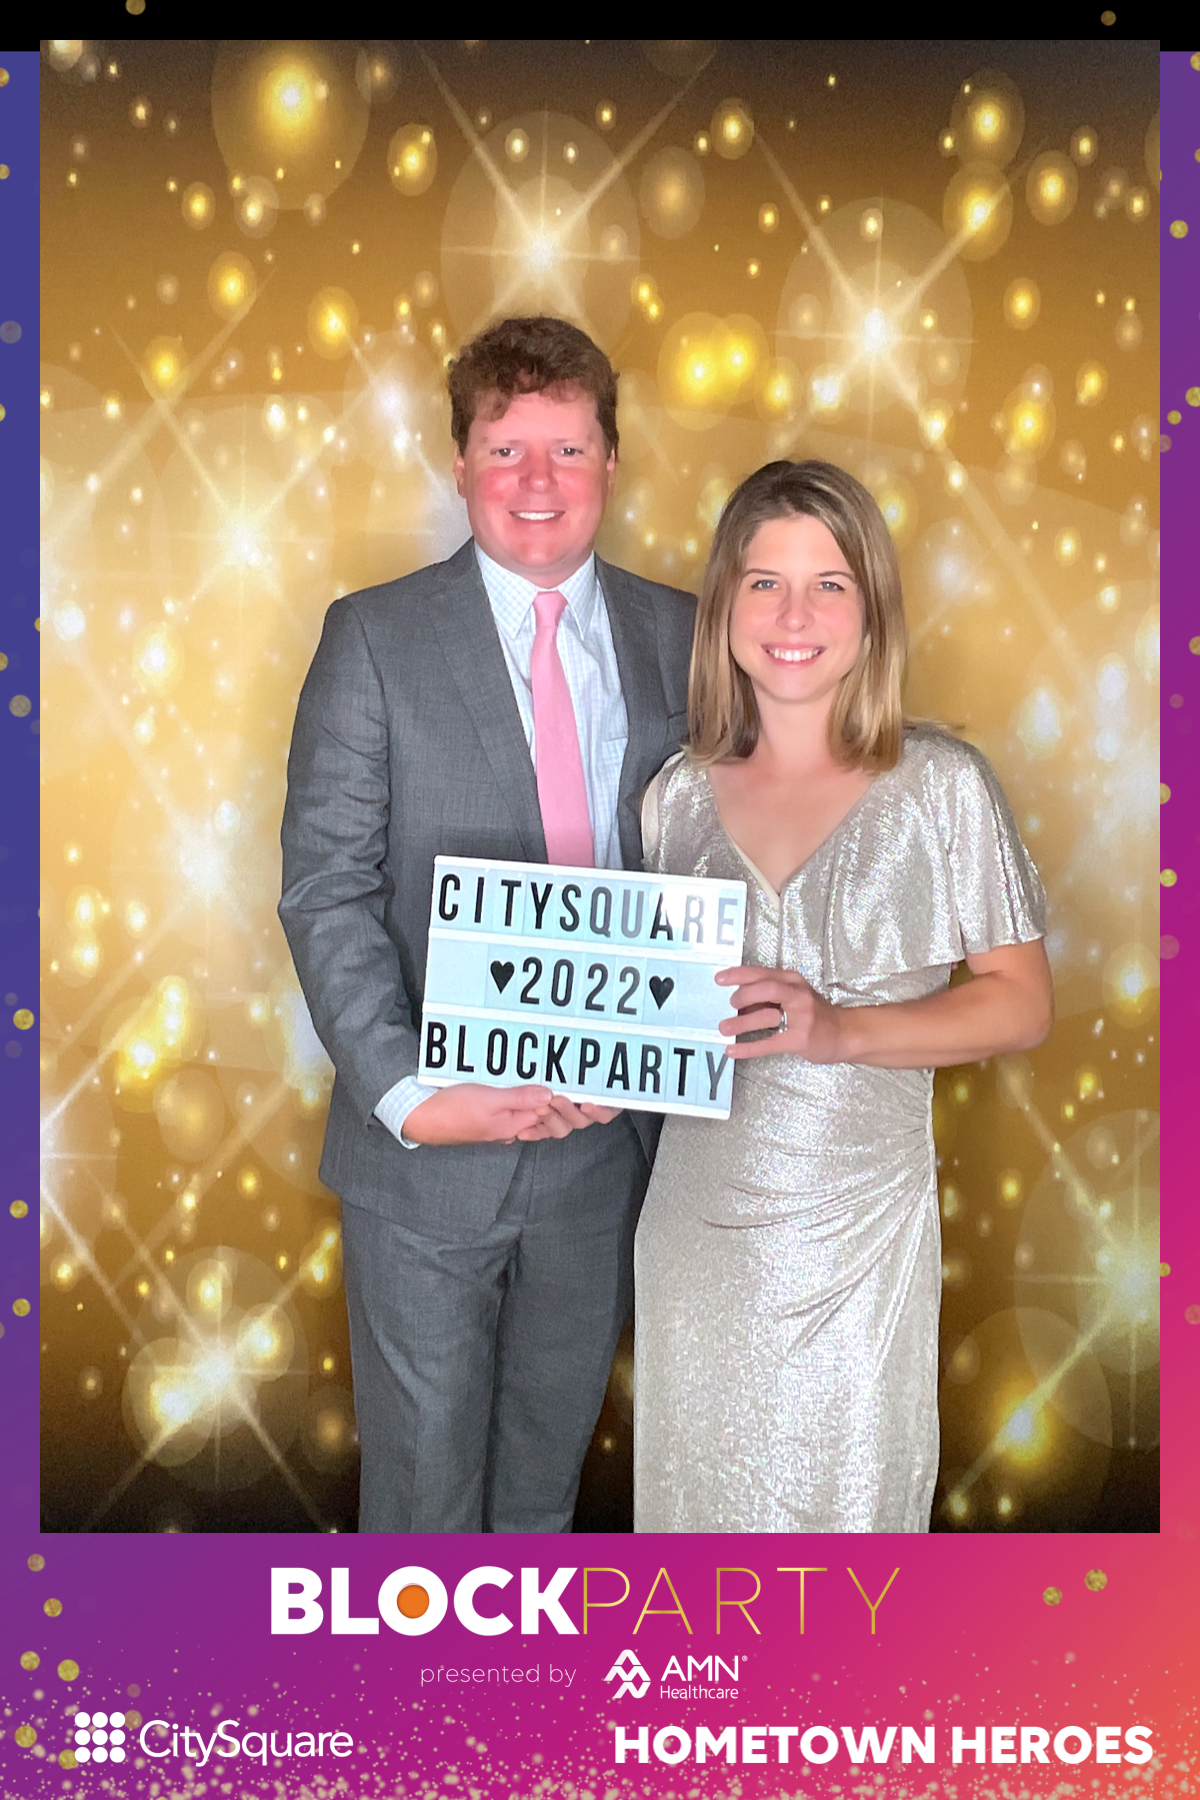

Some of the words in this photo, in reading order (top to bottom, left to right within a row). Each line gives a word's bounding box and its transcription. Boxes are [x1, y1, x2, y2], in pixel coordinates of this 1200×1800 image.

[438, 873, 739, 946] CITYSQUARE
[519, 957, 641, 1015] 2022
[424, 1021, 730, 1101] BLOCKPARTY
